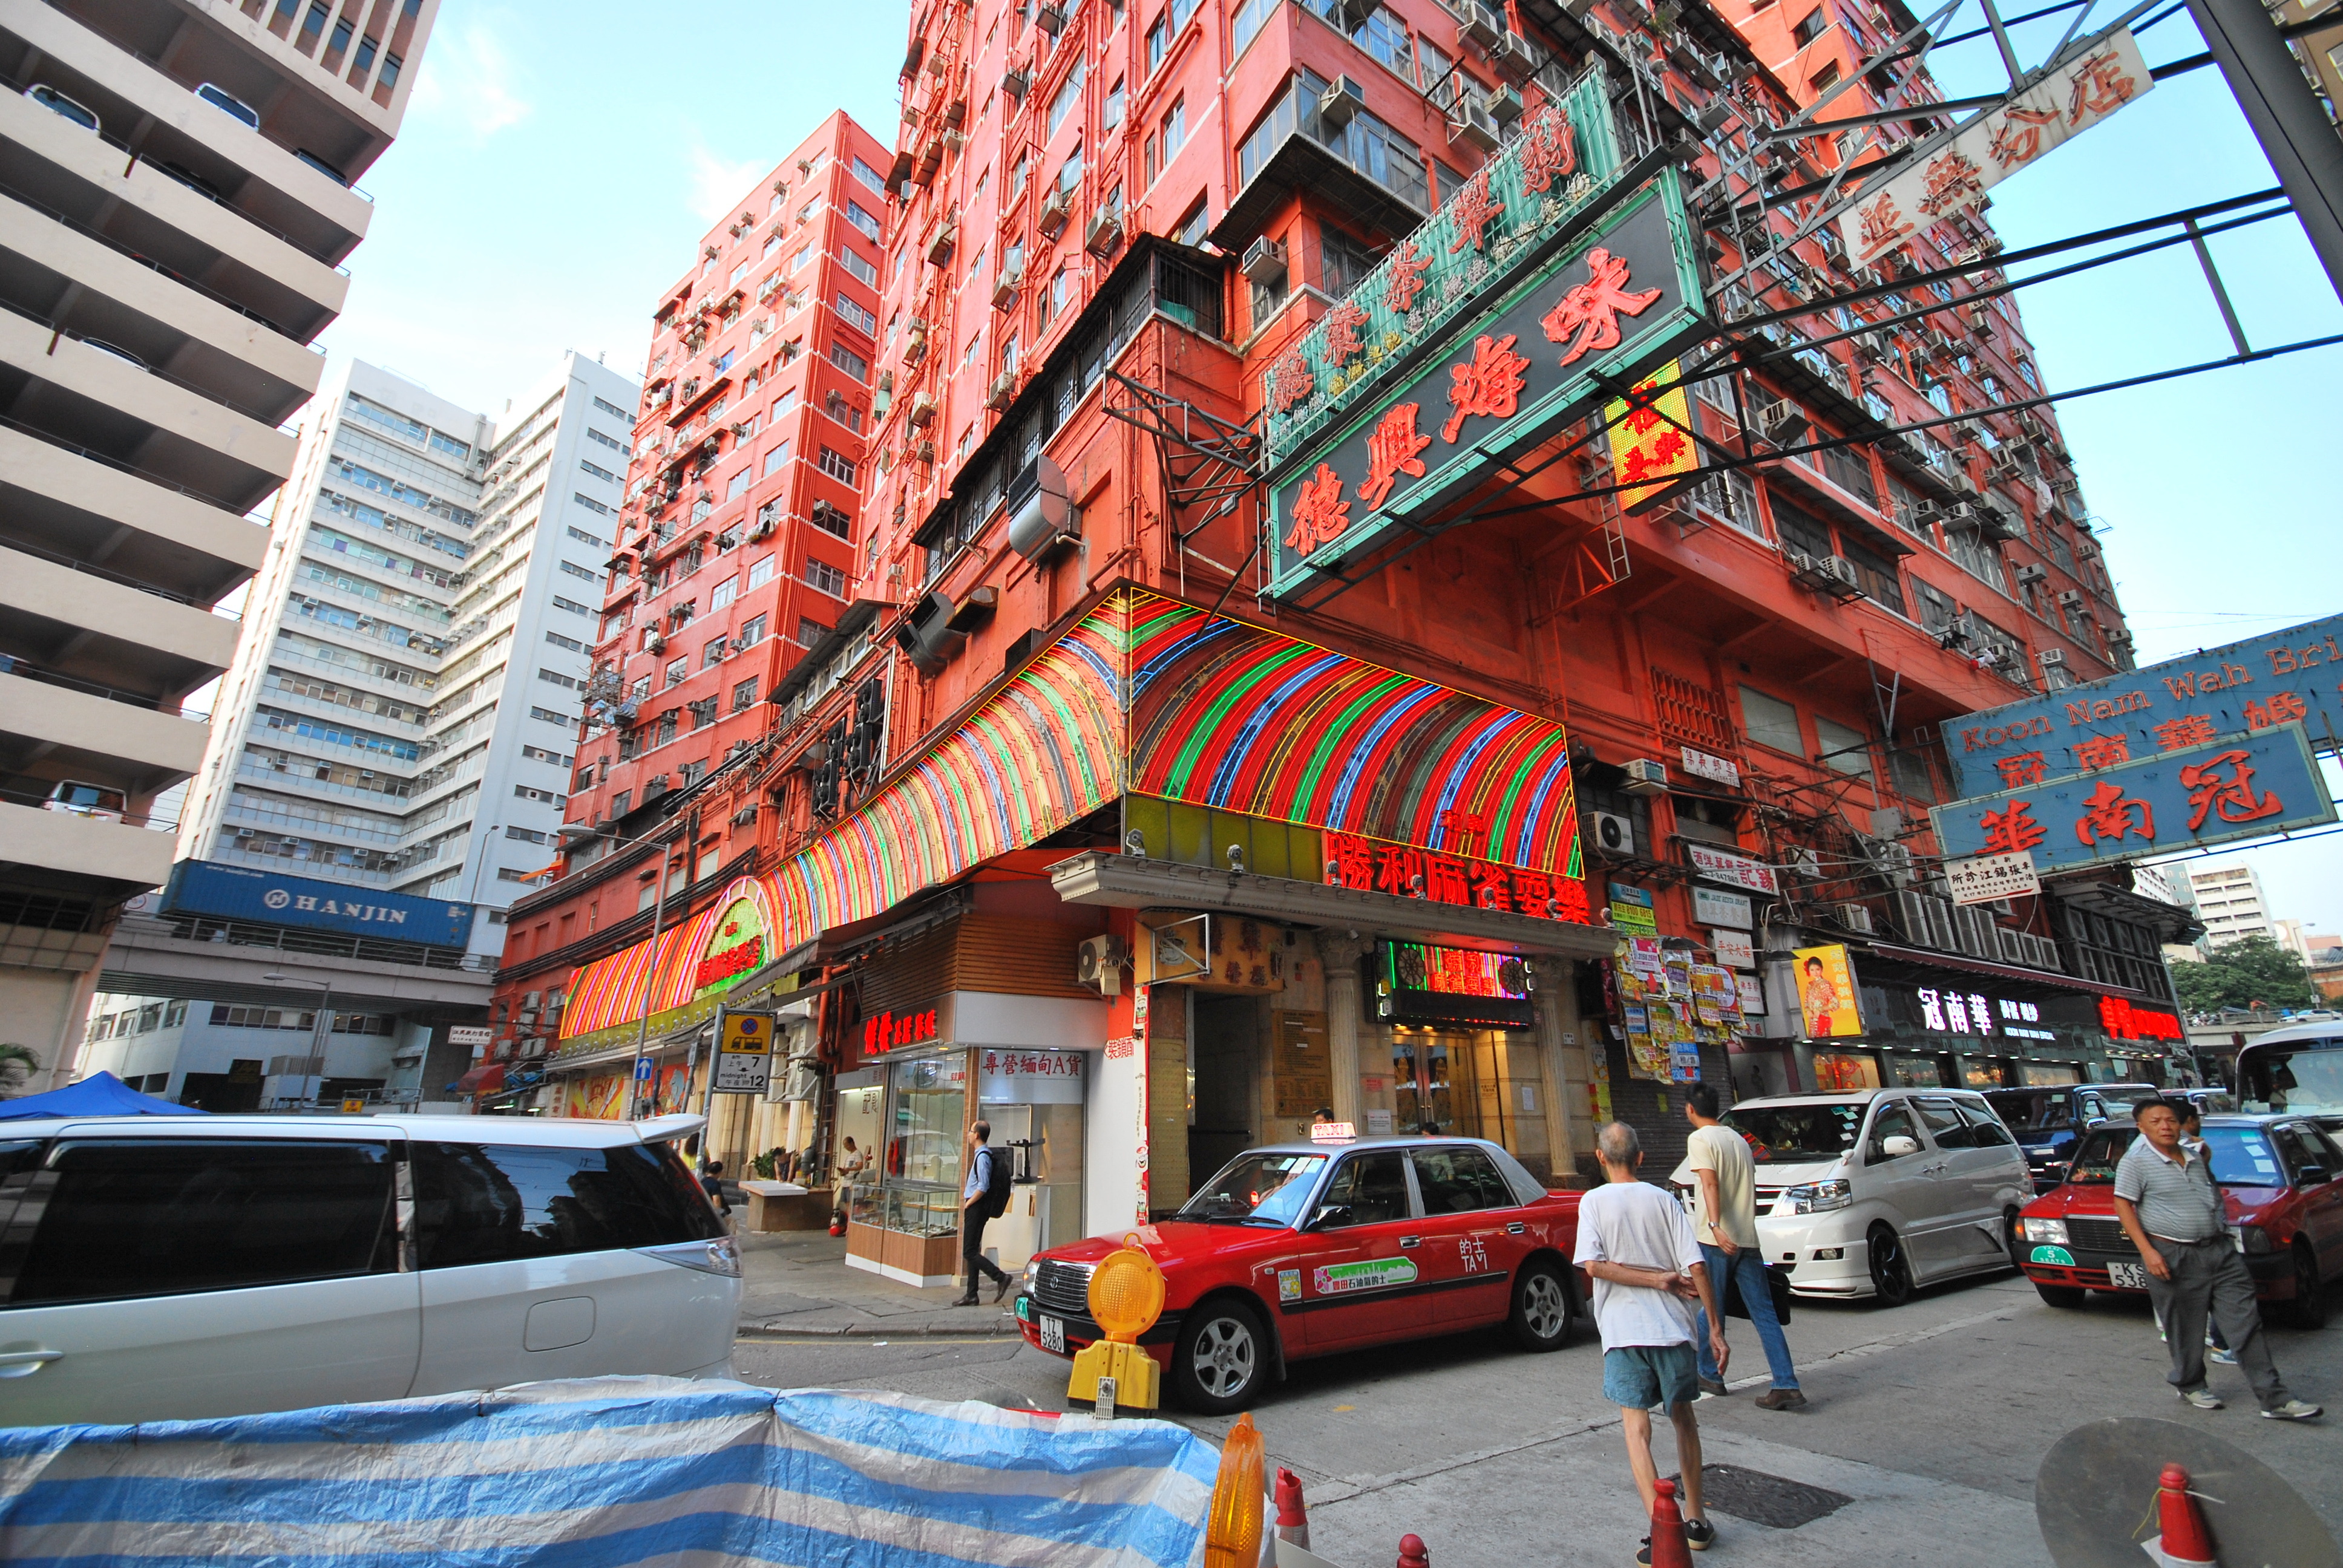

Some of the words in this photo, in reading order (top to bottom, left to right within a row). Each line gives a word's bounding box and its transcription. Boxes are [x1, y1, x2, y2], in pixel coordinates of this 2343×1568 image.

[1282, 246, 1663, 558] 德興海味
[1960, 716, 2054, 752] Koon
[2064, 690, 2152, 725] Nam
[2161, 662, 2255, 701] Wah
[1326, 829, 1591, 926] 勝利麻雀耍樂
[294, 895, 408, 924] HANJIN
[1918, 987, 1992, 1036] 冠南華
[752, 1056, 760, 1068] 7
[982, 1052, 1082, 1076] 專營緬甸A貨
[750, 1075, 765, 1087] 12
[1314, 1124, 1344, 1136] TAXI
[1459, 1235, 1485, 1255] 的士
[2047, 1250, 2056, 1259] 5
[1046, 1318, 1057, 1334] TZ
[1042, 1331, 1063, 1351] 5280
